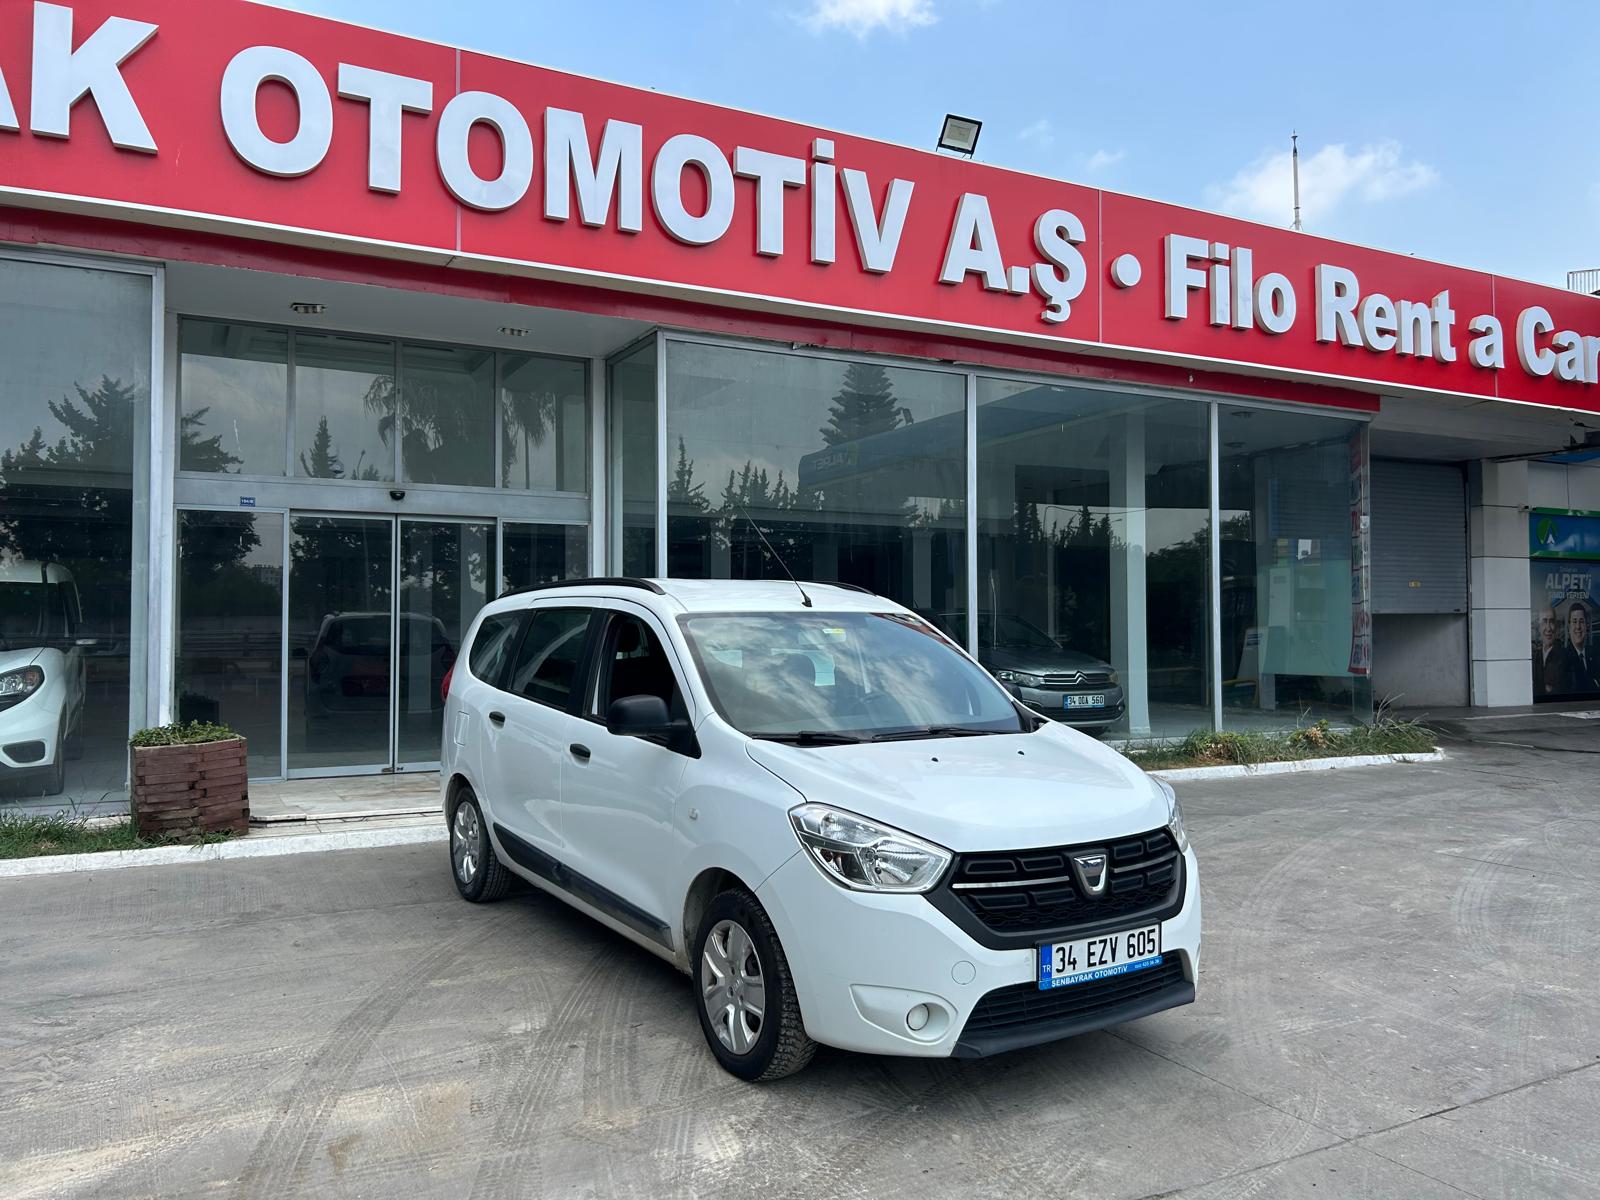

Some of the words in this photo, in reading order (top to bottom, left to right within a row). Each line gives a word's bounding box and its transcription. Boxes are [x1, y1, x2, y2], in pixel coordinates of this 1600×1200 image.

[0, 0, 159, 155] K
[220, 45, 915, 275] OTOMOTİV
[1164, 233, 1297, 336] Filo
[1314, 263, 1457, 363] Rent
[1468, 314, 1505, 370] a
[1516, 306, 1600, 384] Car
[1068, 696, 1076, 705] 34
[1091, 695, 1103, 704] 560
[1055, 944, 1077, 973] 34
[1087, 936, 1118, 968] EZV
[1127, 928, 1156, 959] 605
[1042, 964, 1051, 973] TR
